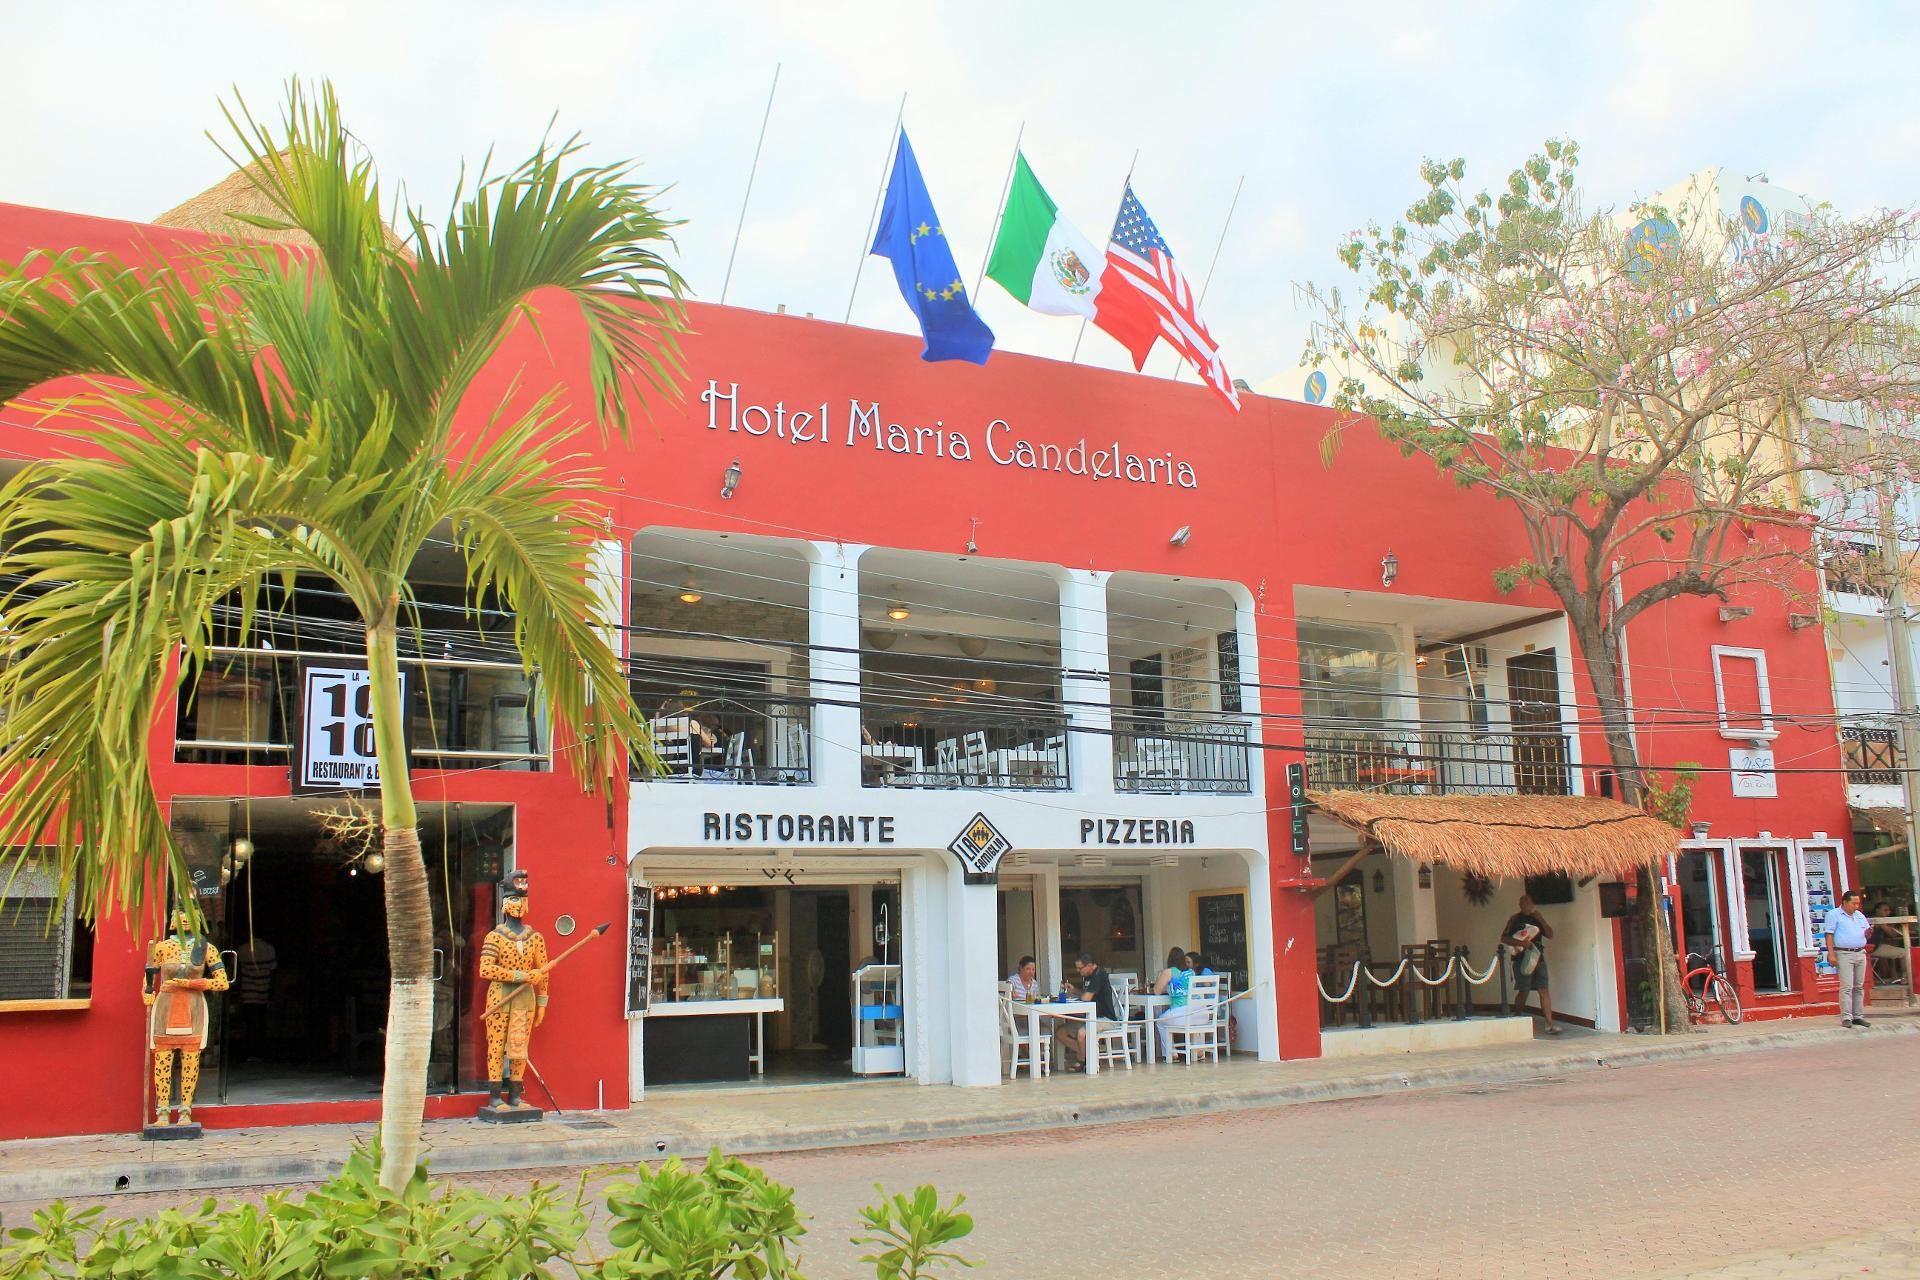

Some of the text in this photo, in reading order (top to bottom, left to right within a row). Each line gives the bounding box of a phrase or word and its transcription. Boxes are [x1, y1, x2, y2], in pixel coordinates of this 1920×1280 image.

[700, 379, 1199, 489] Hotel Maria Candelaria
[352, 672, 360, 681] LA
[313, 761, 365, 780] RESTAURANT
[367, 765, 373, 779] &
[1290, 766, 1304, 850] HOTEL
[703, 812, 895, 843] RISTORANTE
[1080, 818, 1195, 844] PIZZERIA
[956, 836, 980, 862] LA
[974, 837, 1005, 872] FAMIGLIA
